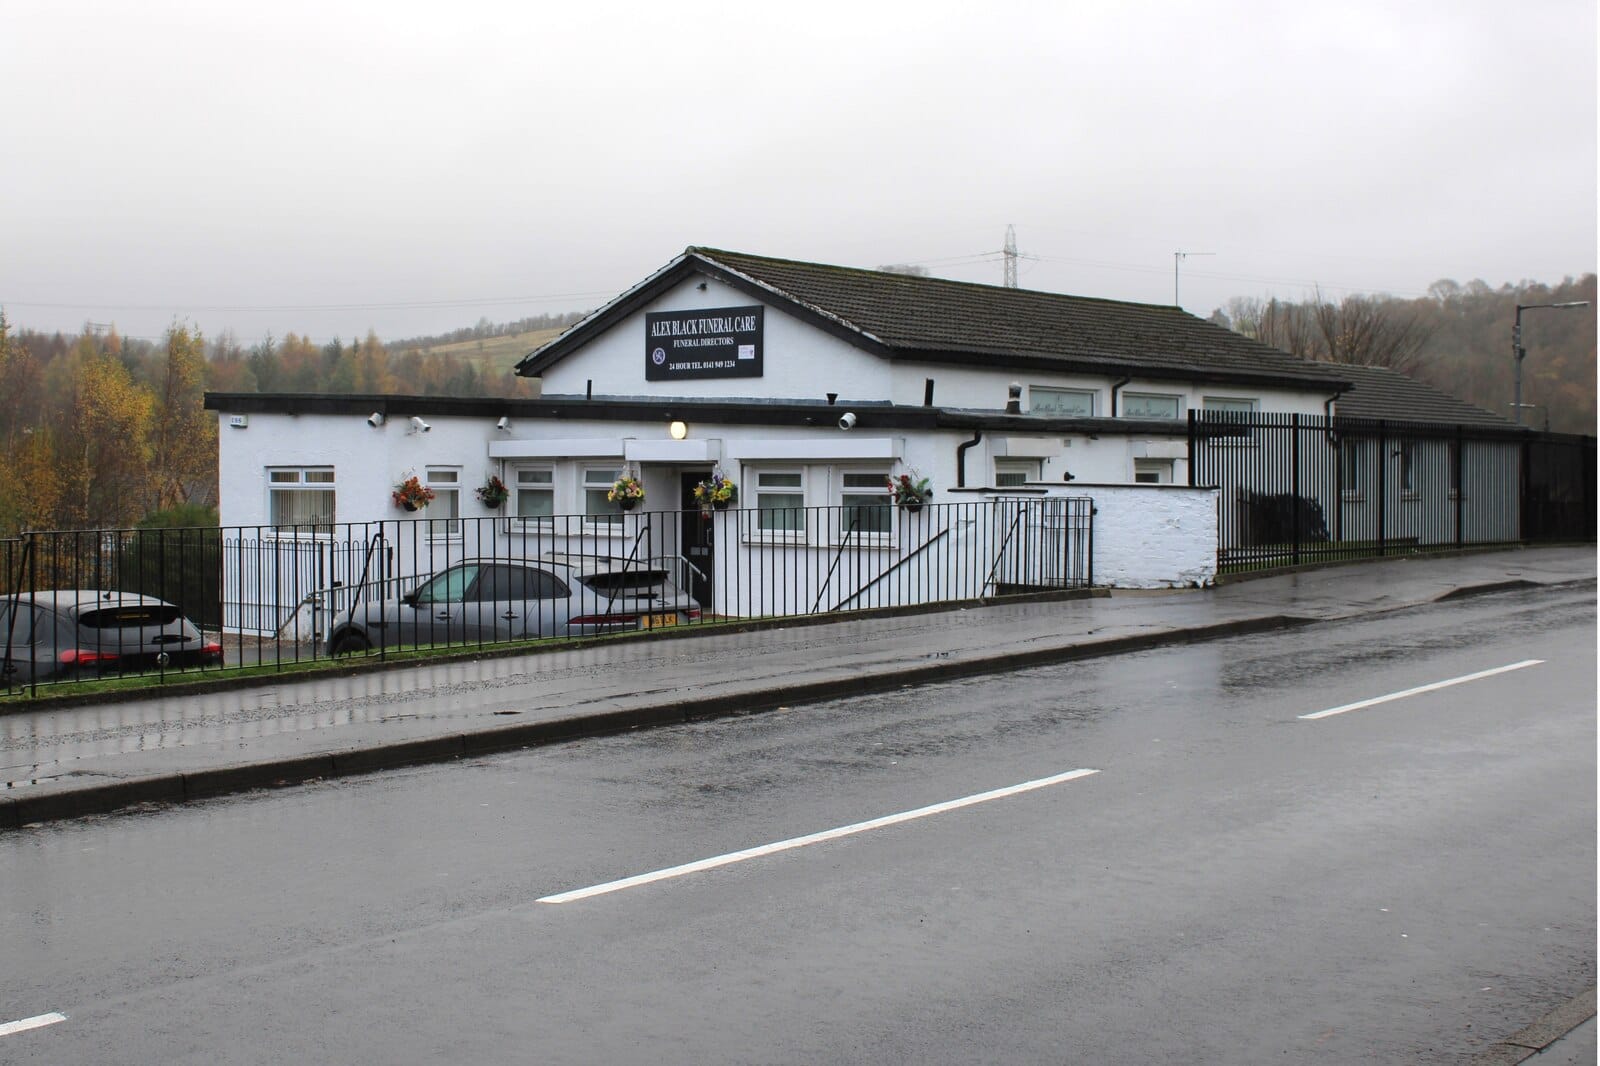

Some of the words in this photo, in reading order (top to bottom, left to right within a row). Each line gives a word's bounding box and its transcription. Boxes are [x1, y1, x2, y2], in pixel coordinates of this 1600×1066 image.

[652, 321, 671, 336] ALEX
[672, 320, 698, 336] BLACK
[699, 318, 734, 334] FUNERAL
[735, 316, 756, 332] CARE
[673, 340, 700, 348] FUNERAL
[700, 337, 734, 346] DIRECTORS
[669, 362, 675, 370] 24
[676, 362, 691, 370] HOUR
[703, 361, 714, 369] 0141
[724, 360, 736, 368] 1234
